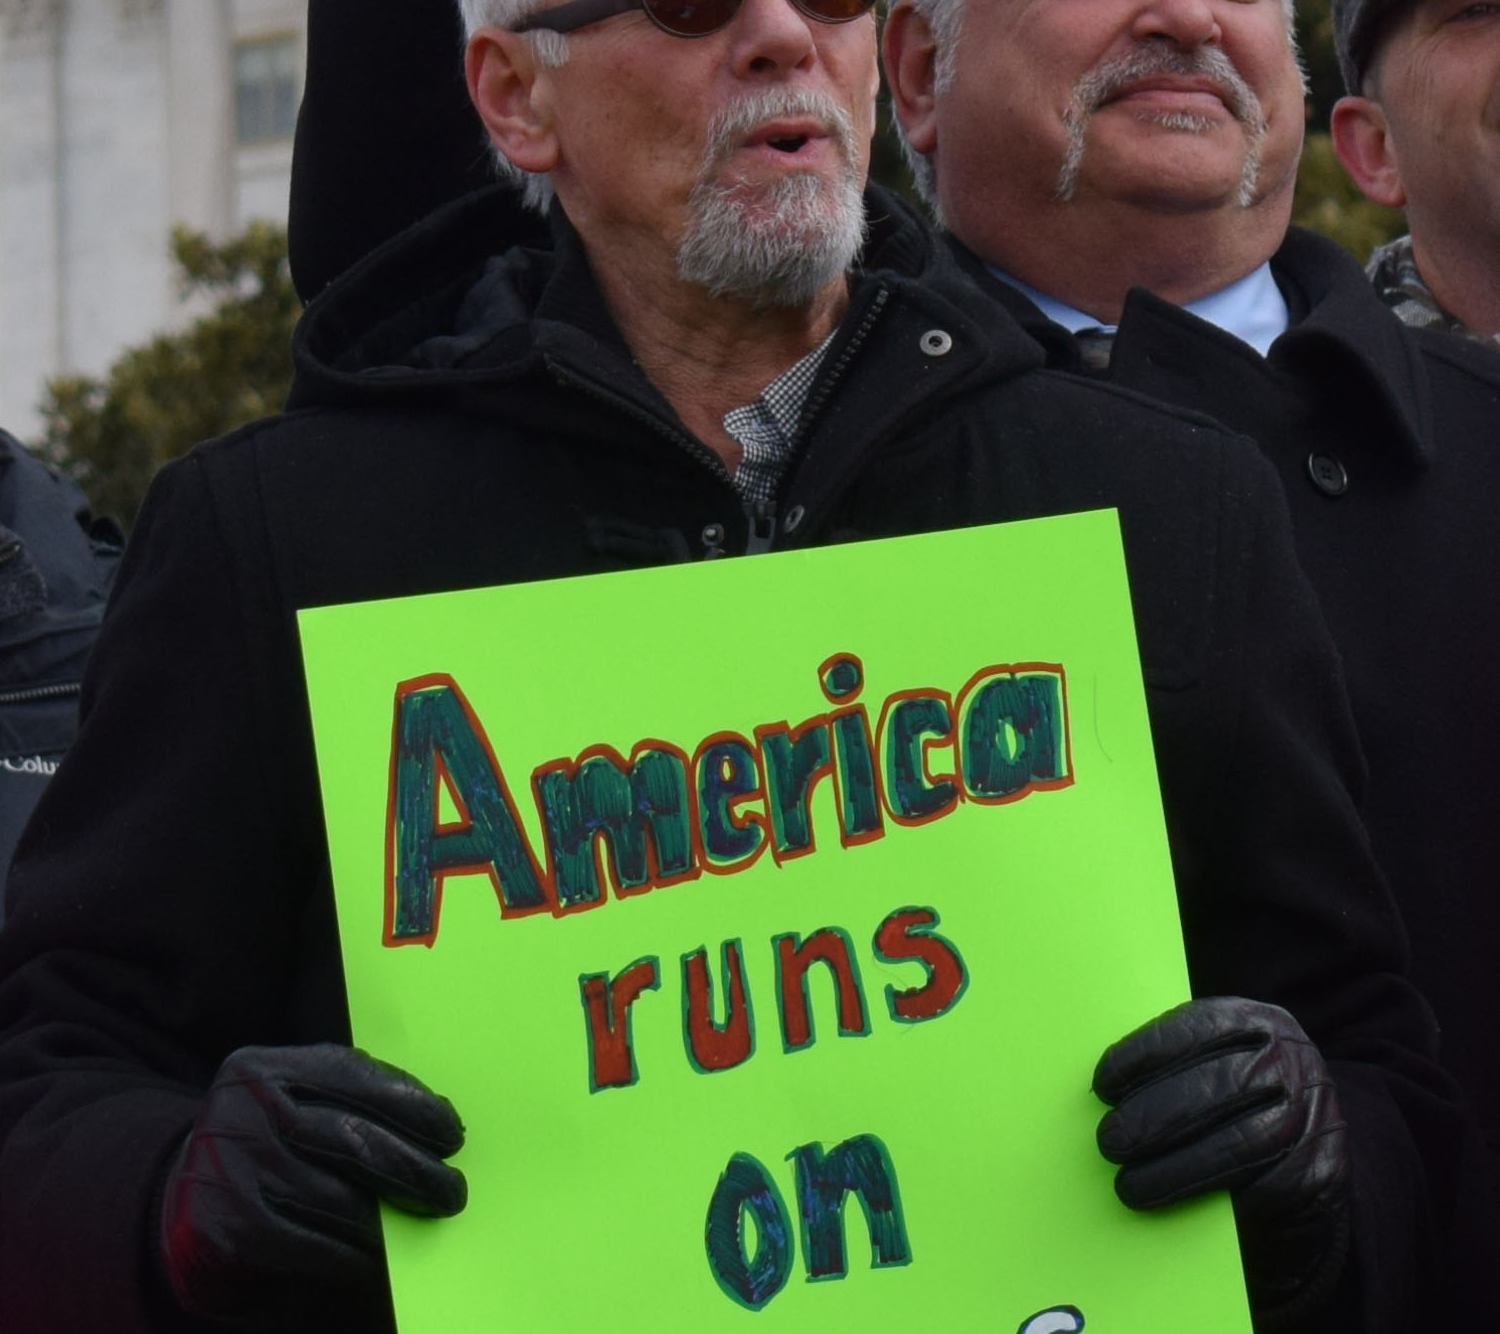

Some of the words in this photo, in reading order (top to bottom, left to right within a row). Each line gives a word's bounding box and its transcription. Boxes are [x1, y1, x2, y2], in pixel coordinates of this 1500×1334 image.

[381, 652, 1074, 948] America
[576, 903, 969, 1094] runs
[703, 1128, 913, 1312] on
